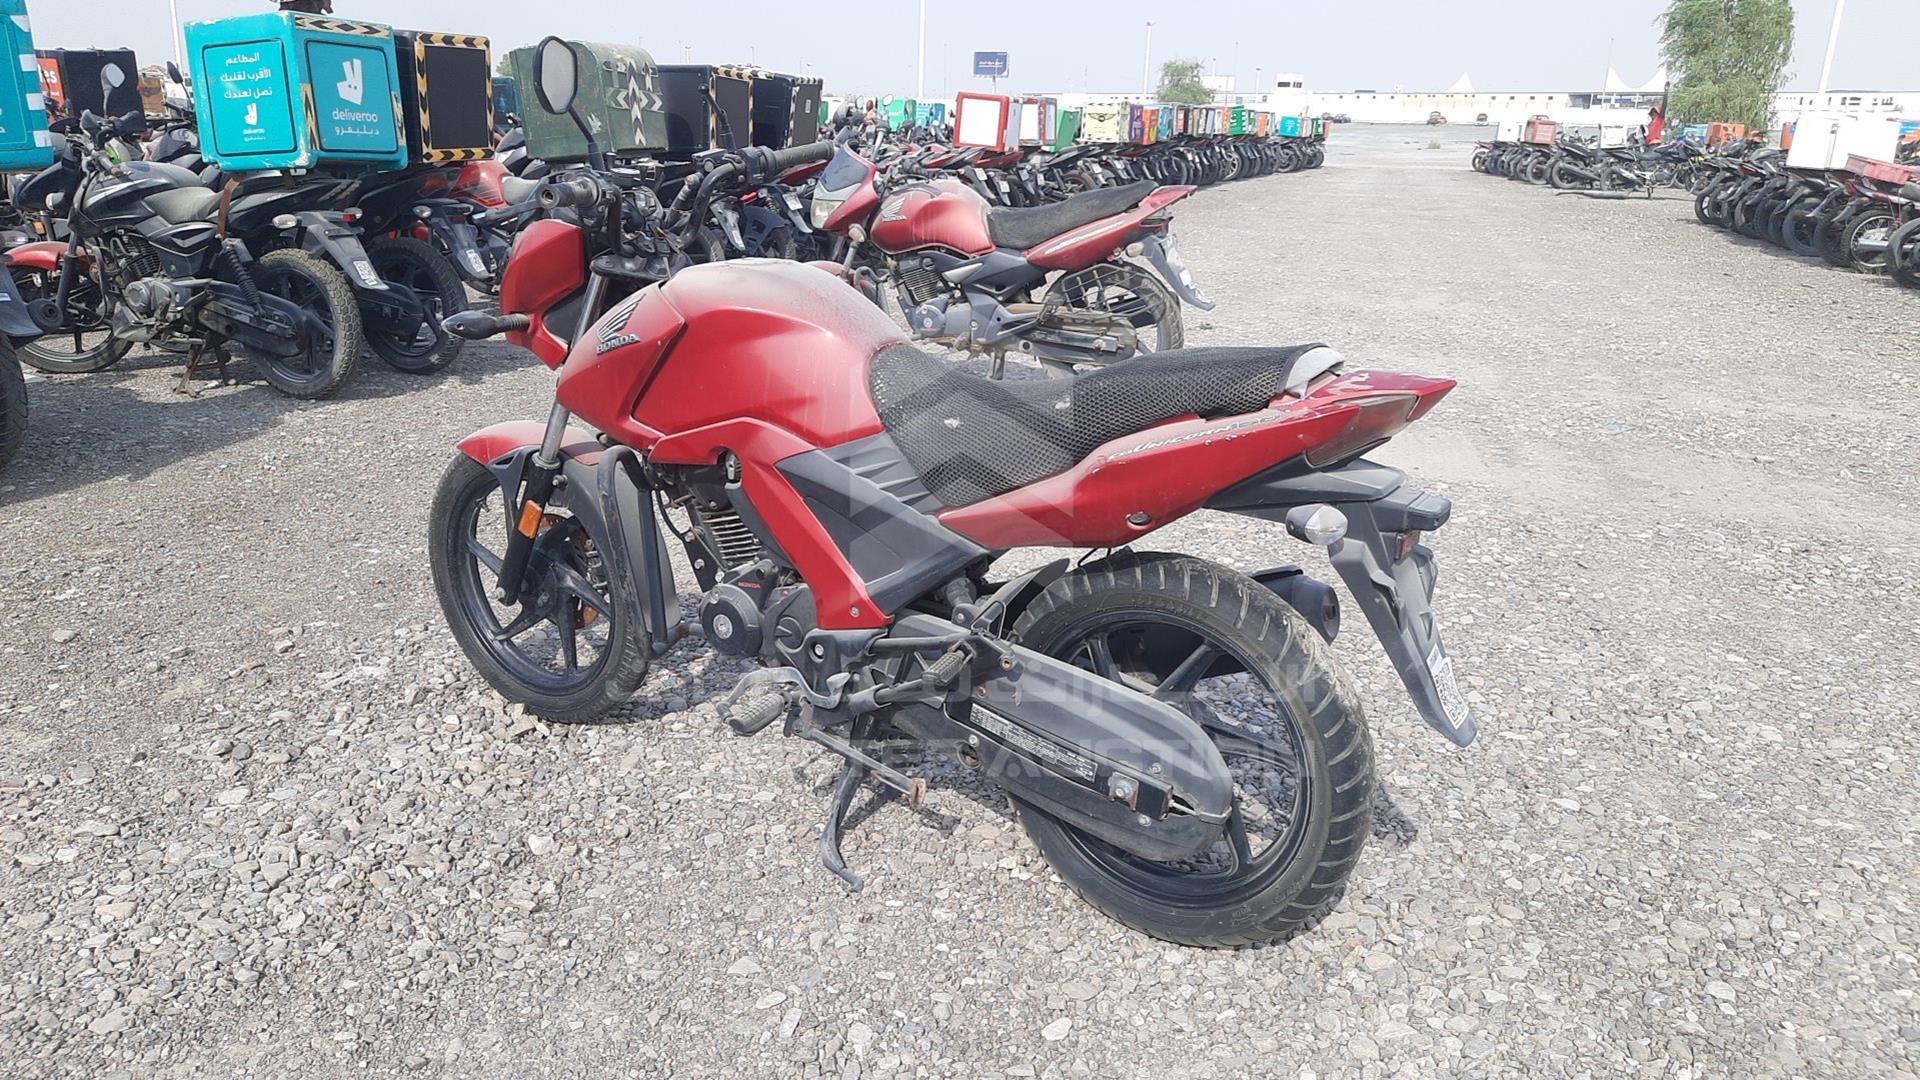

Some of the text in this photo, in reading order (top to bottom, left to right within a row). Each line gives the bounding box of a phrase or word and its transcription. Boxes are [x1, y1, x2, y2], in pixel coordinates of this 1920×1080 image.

[225, 52, 260, 66] المطاعم
[332, 107, 378, 122] deliveroo
[335, 124, 380, 136] ديليفرو
[597, 334, 641, 355] HONDA
